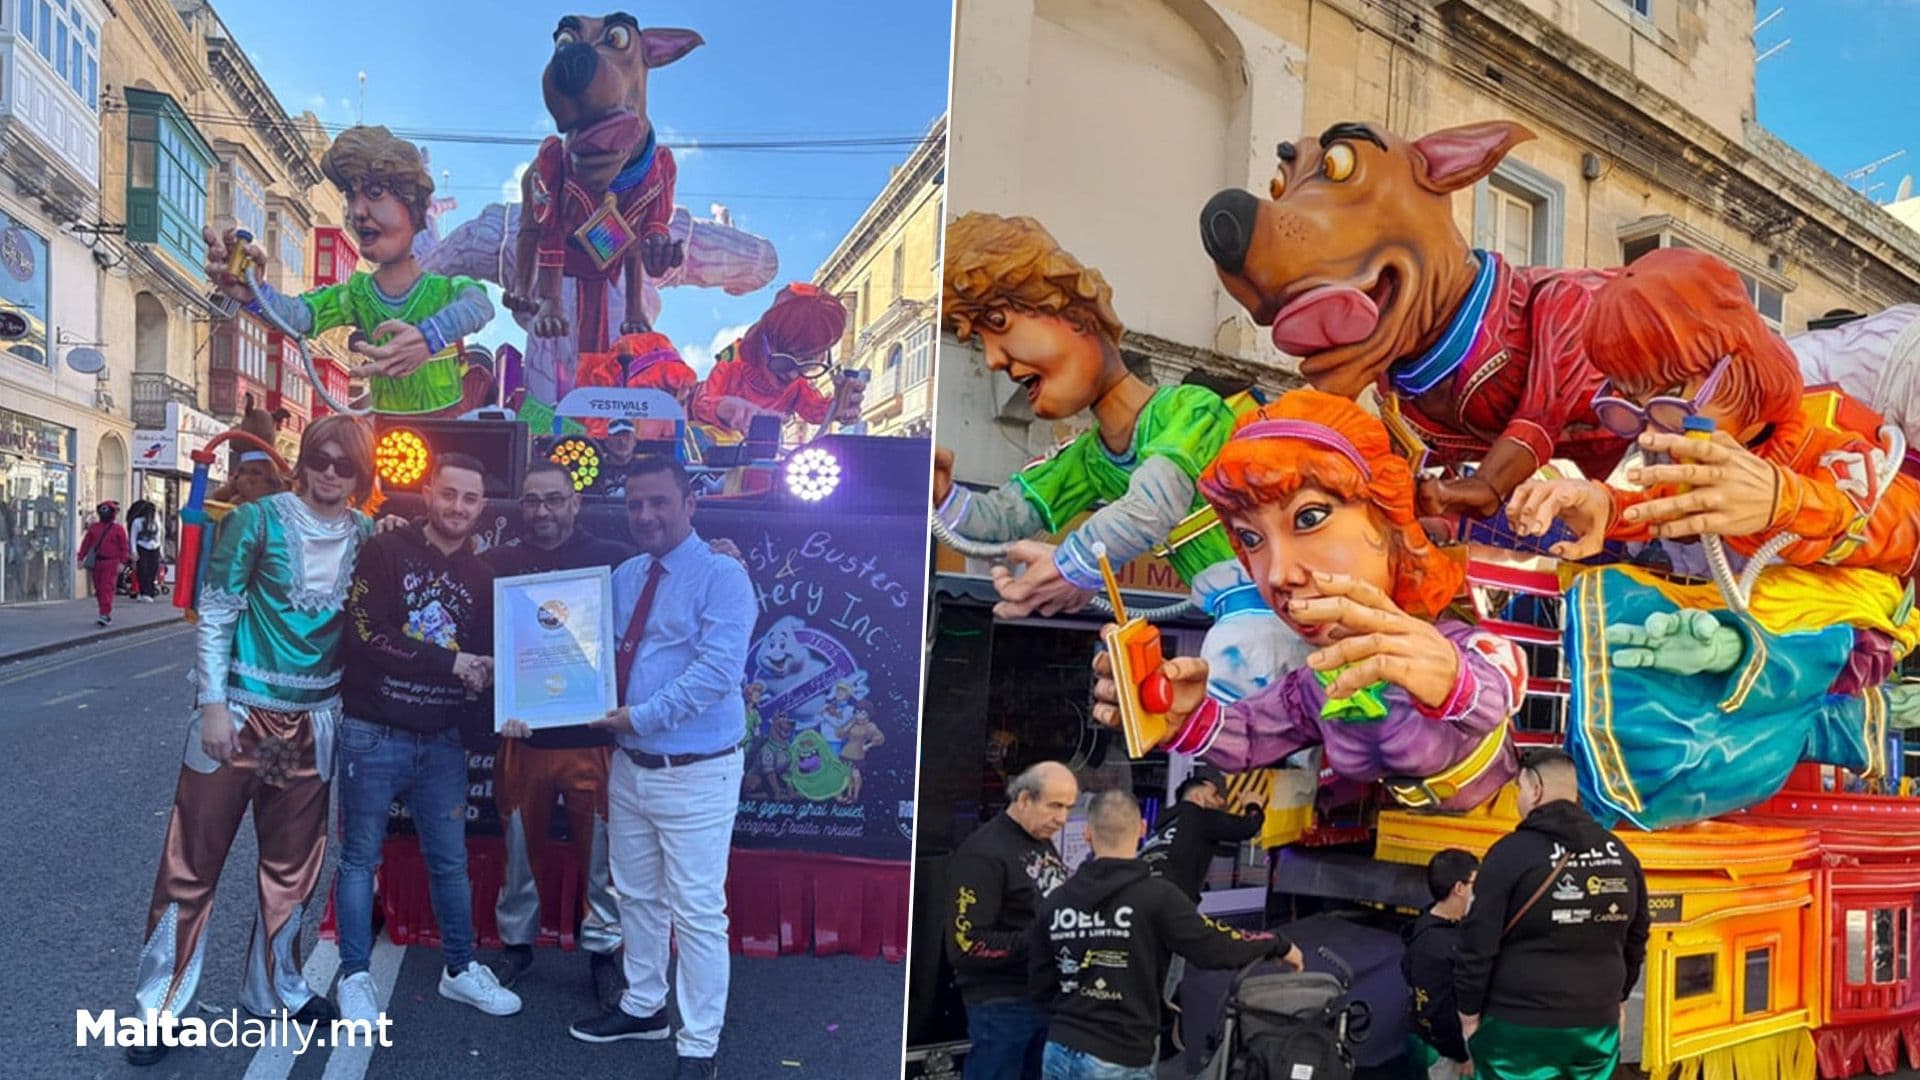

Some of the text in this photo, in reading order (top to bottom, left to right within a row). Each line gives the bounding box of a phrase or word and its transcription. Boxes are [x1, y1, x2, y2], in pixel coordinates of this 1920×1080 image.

[590, 399, 649, 411] FESTIVALS
[750, 530, 909, 608] st Busters
[756, 580, 824, 615] tery
[1605, 841, 1620, 857] C
[1049, 906, 1134, 931] JOEL C
